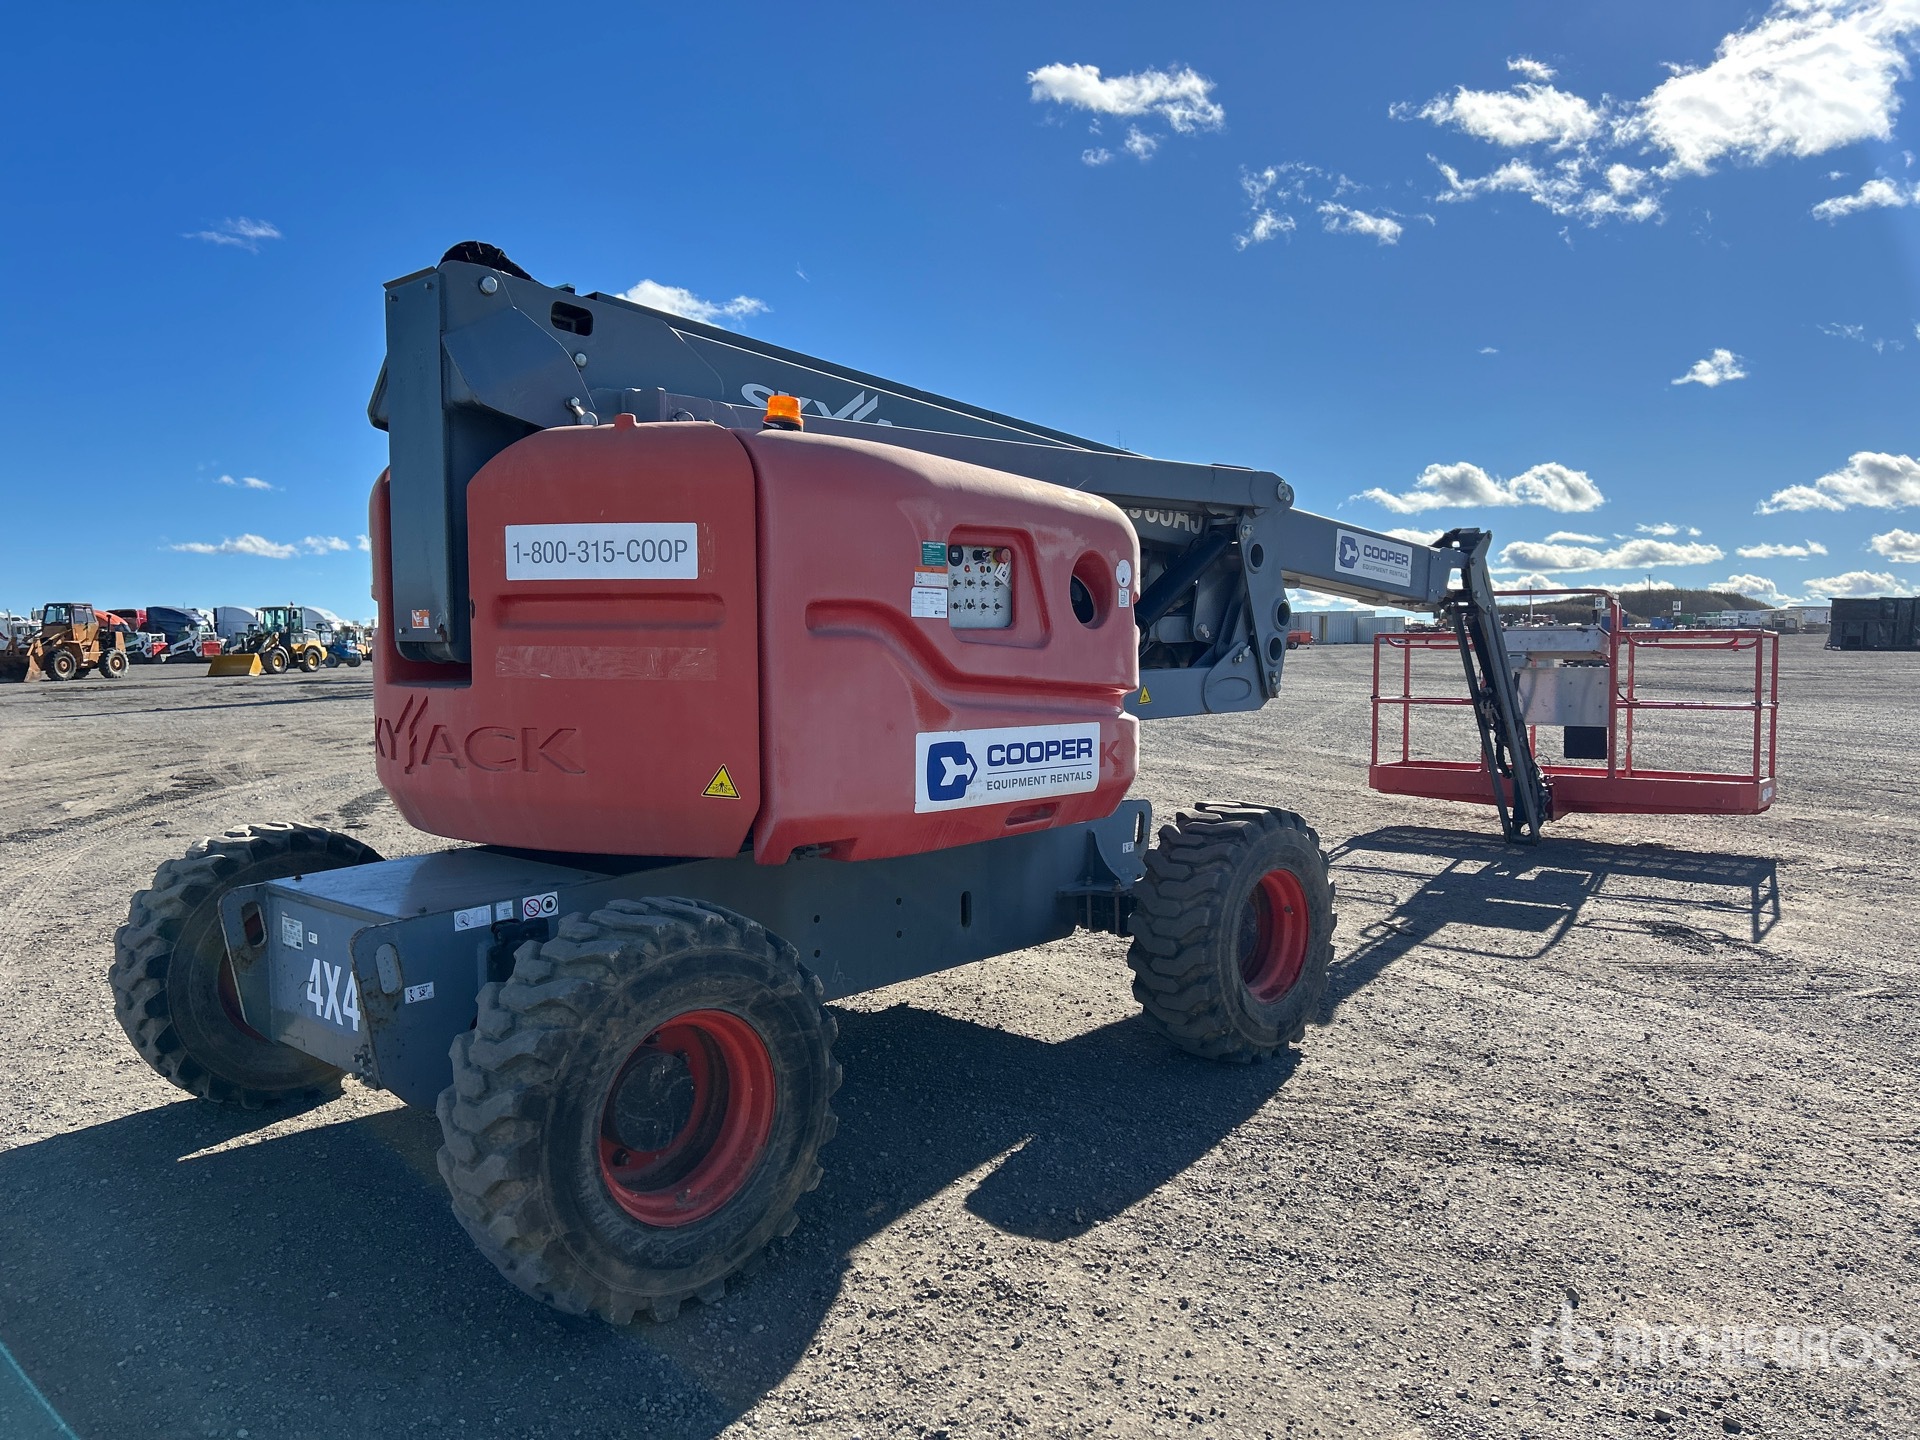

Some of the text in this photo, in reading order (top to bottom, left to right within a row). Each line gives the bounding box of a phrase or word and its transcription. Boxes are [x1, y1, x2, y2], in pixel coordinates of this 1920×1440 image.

[512, 539, 688, 565] 1-800-315-COOP
[1363, 544, 1409, 567] COOPER
[1362, 563, 1408, 579] EQUIPMENT RENTALS
[374, 693, 586, 775] KYJACK
[986, 737, 1093, 767] COOPER
[986, 770, 1093, 791] EQUIPMENT RENTALS
[306, 957, 361, 1032] 4X4
